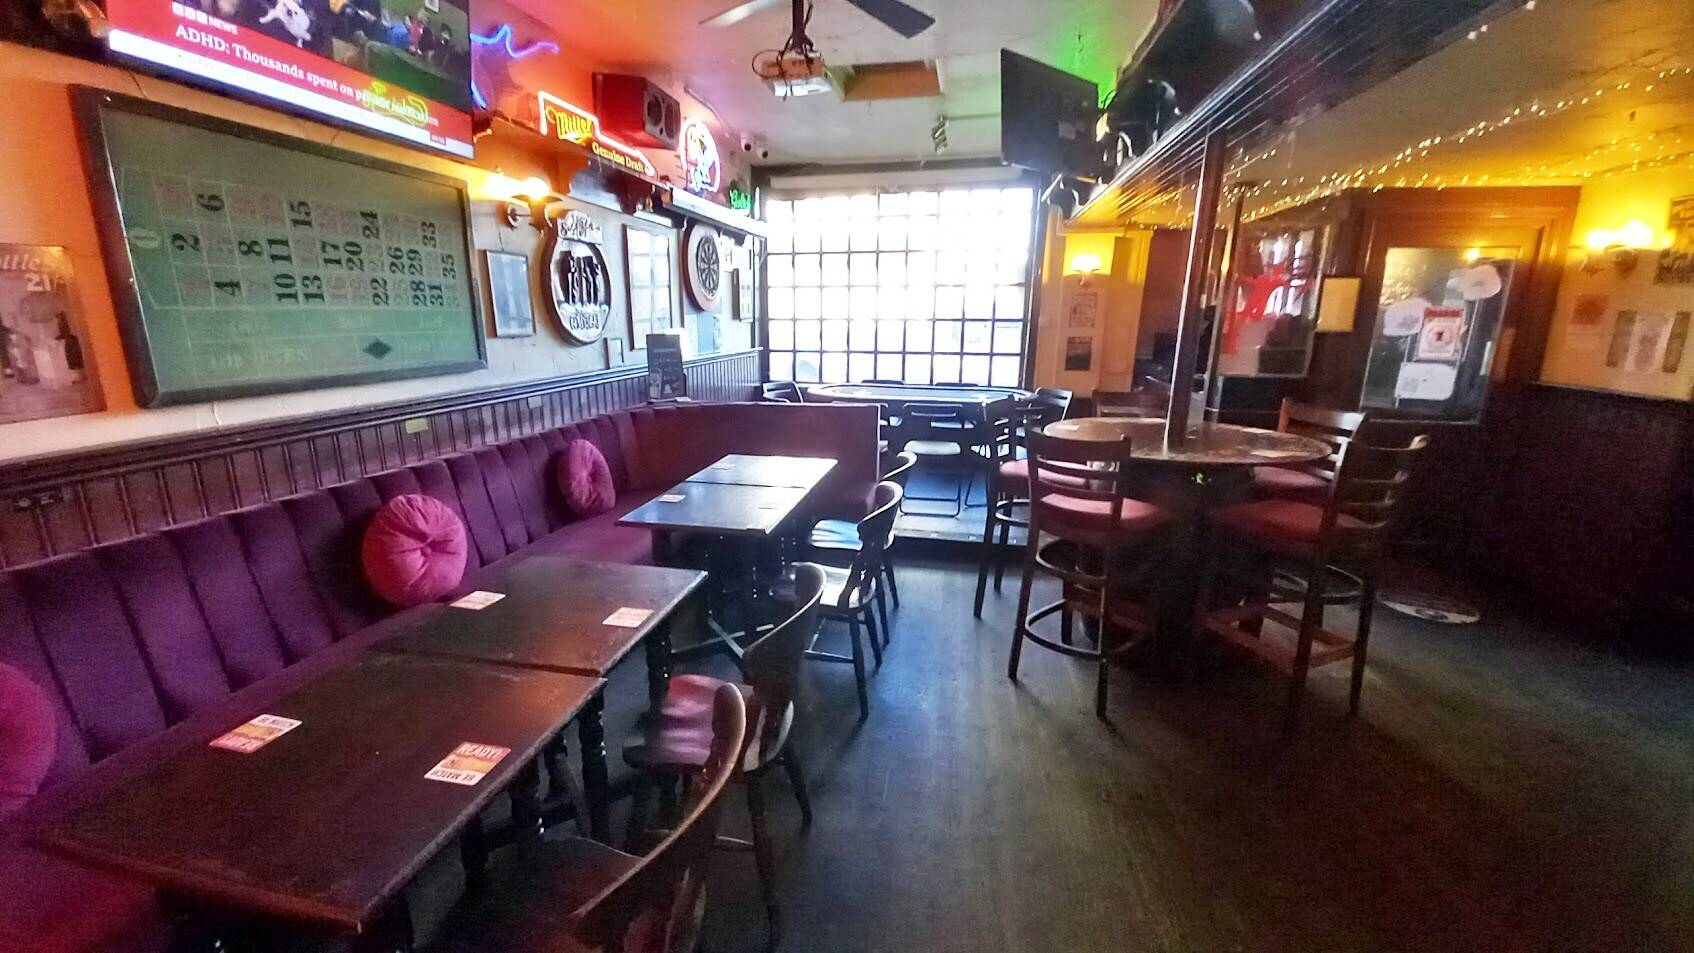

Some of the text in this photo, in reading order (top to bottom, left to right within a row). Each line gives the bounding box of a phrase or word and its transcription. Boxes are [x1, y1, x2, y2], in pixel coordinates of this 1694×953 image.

[208, 16, 238, 35] NEWS
[175, 24, 230, 54] ADHD:
[232, 43, 305, 79] Thousands
[306, 72, 338, 92] spent
[339, 84, 354, 98] on
[546, 105, 592, 139] Miller
[592, 141, 645, 173] Genuine Draft
[197, 194, 225, 211] 6
[290, 200, 312, 228] 15
[360, 209, 380, 240] 24
[421, 221, 437, 248] 33
[171, 233, 200, 251] 2
[238, 240, 263, 256] 8
[321, 241, 344, 269] 17
[266, 238, 298, 303] 10 11
[344, 241, 364, 272] 20
[388, 246, 405, 275] 26
[405, 248, 423, 276] 29
[442, 253, 456, 280] 35
[214, 279, 242, 297] 4
[302, 275, 325, 302] 13
[370, 277, 389, 306] 22
[410, 280, 427, 307] 28
[428, 283, 444, 307] 31
